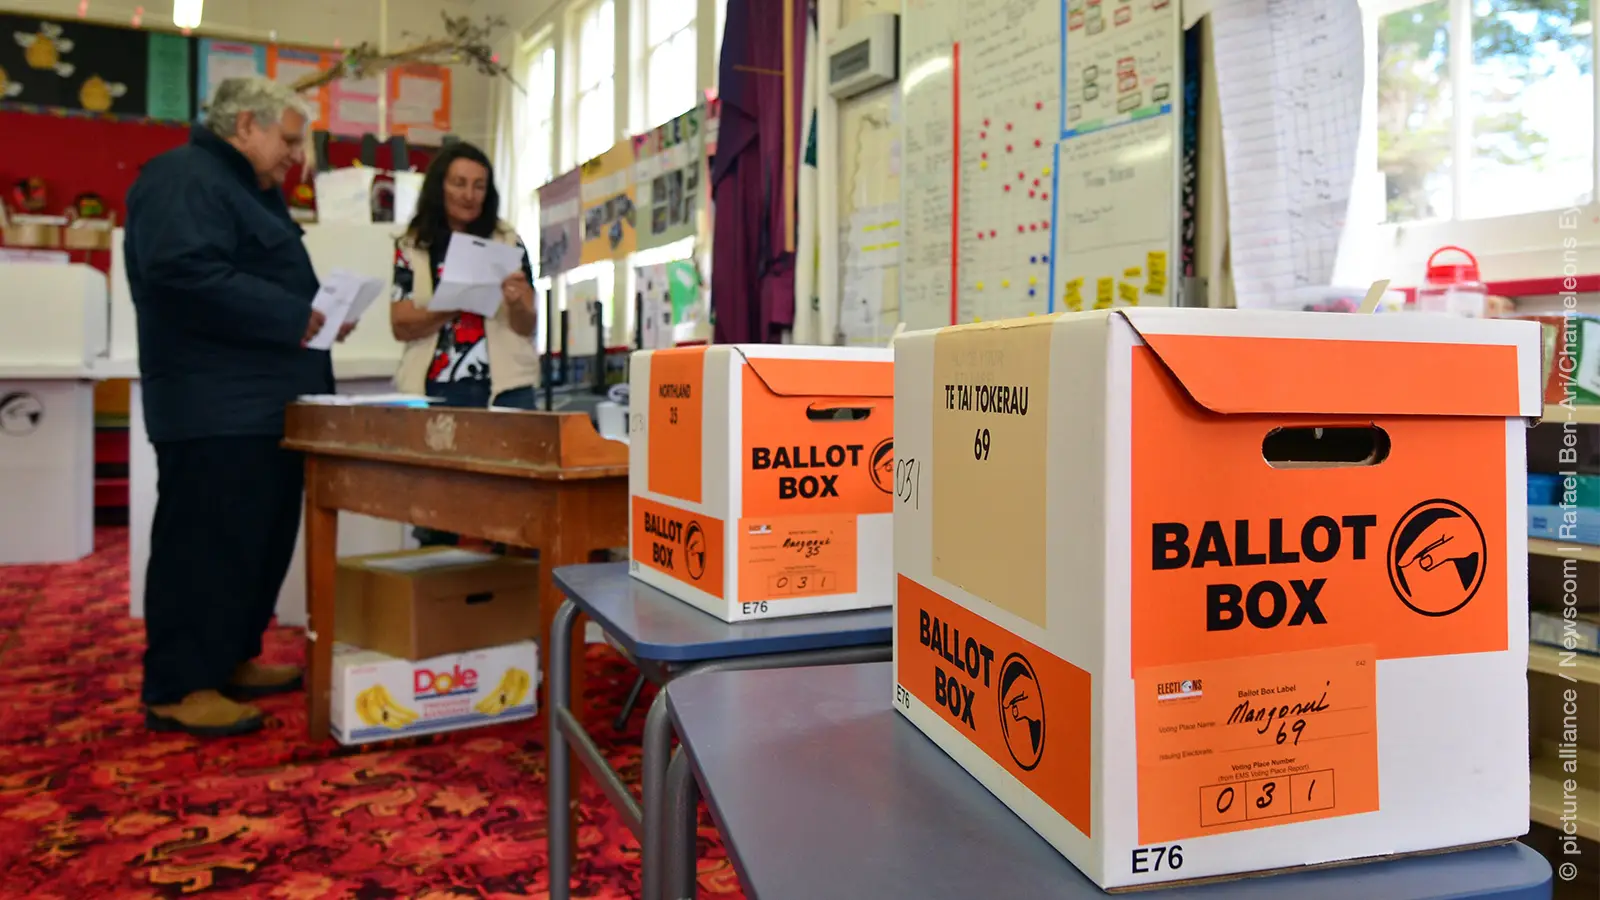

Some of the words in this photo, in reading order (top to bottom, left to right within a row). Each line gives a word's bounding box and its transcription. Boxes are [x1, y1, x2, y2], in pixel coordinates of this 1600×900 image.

[659, 384, 691, 399] NORTHLAND
[945, 385, 955, 410] TE
[958, 385, 972, 411] TAI
[975, 385, 1028, 416] TOKERAU
[752, 444, 864, 470] BALLOT
[974, 428, 991, 461] 69
[779, 475, 839, 499] BOX
[896, 458, 920, 510] 031
[644, 512, 683, 544] BALLOT
[805, 546, 820, 558] 35
[1152, 514, 1377, 571] BALLOT
[652, 543, 674, 570] BOX
[743, 601, 768, 615] E76
[1206, 578, 1328, 632] BOX
[920, 608, 994, 689] BALLOT
[413, 664, 478, 694] Dole
[1238, 688, 1260, 698] Ballot
[1261, 687, 1275, 696] Box
[1277, 684, 1296, 694] Label
[896, 684, 910, 709] E76
[935, 666, 976, 732] BOX
[1276, 719, 1306, 746] 69
[1231, 763, 1252, 772] Voting
[1253, 760, 1271, 768] Place
[1271, 757, 1296, 766] Number
[1235, 772, 1250, 780] EMS
[1251, 769, 1269, 777] Voting
[1132, 845, 1183, 873] E76
